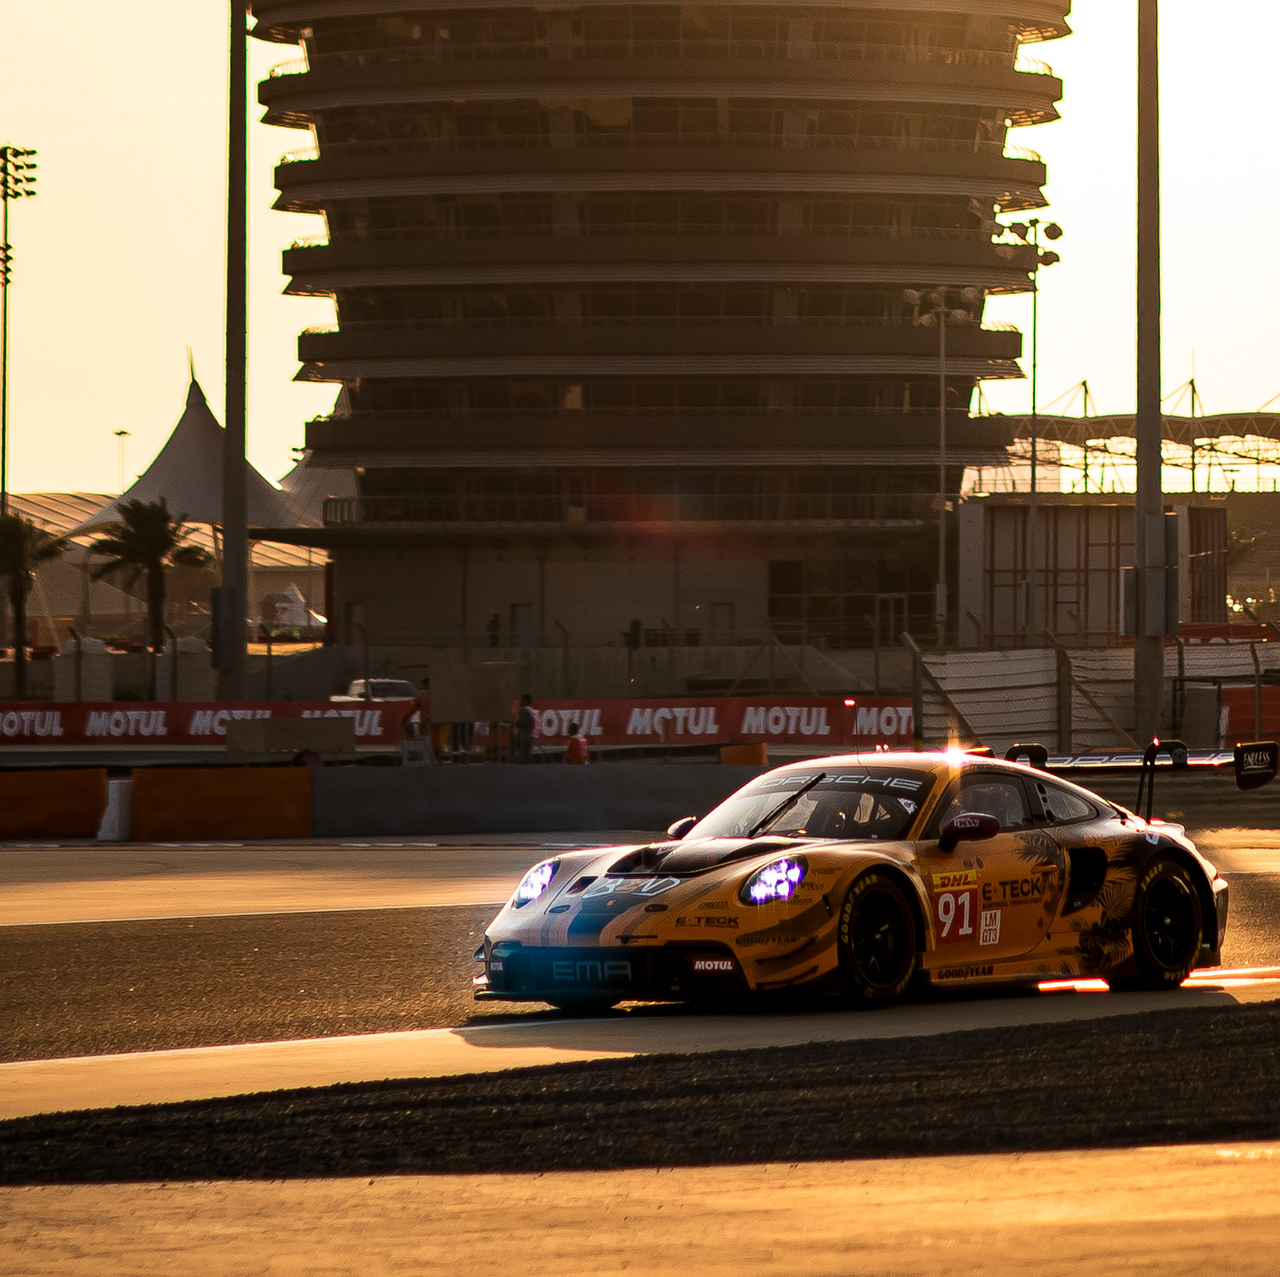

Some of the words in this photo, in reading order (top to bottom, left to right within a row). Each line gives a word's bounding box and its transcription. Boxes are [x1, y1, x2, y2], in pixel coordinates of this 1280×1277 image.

[83, 710, 169, 737] MOTUL
[741, 707, 832, 735] MOTUL
[852, 707, 914, 736] MOT
[939, 874, 970, 888] DHL
[938, 891, 973, 938] 91
[984, 912, 998, 927] LM
[981, 928, 998, 944] GT3
[694, 961, 734, 971] MOTUL
